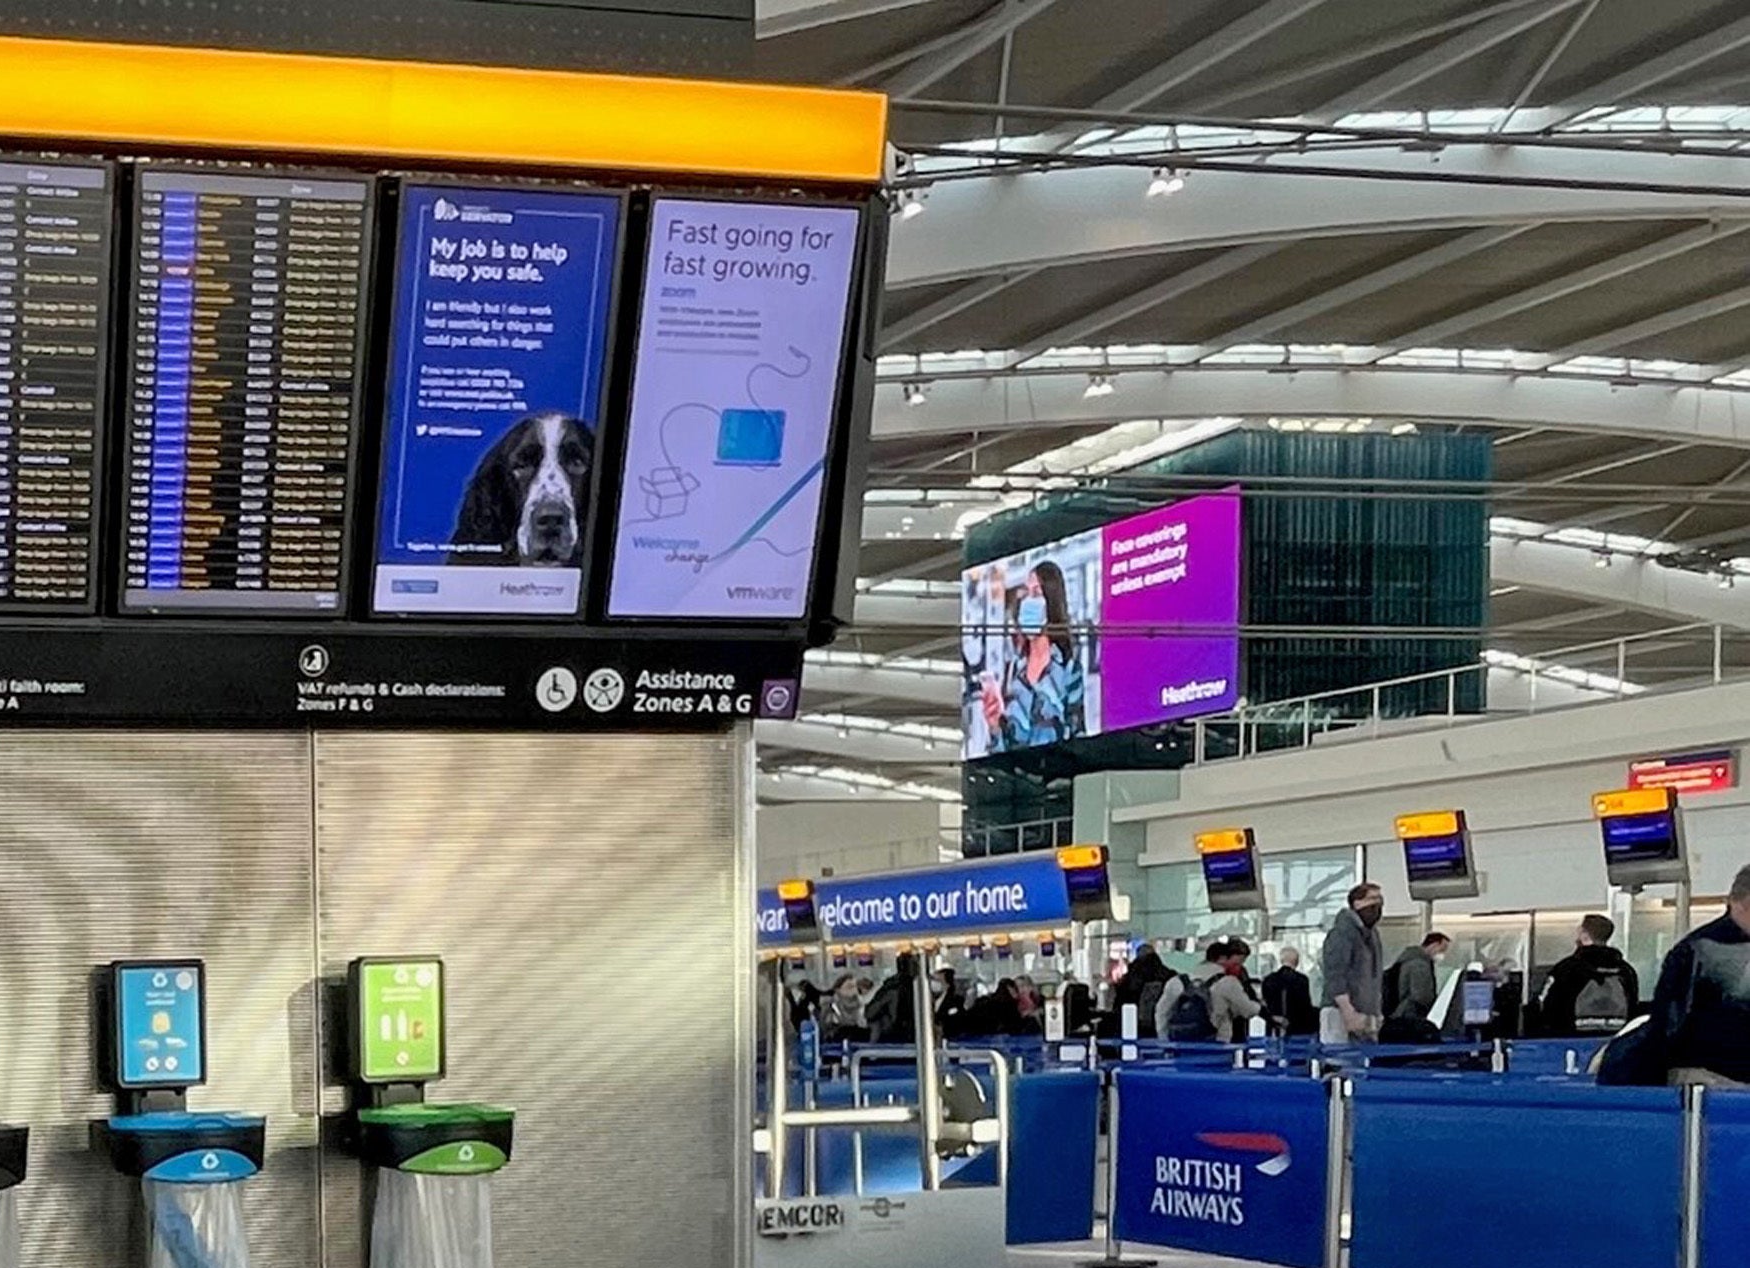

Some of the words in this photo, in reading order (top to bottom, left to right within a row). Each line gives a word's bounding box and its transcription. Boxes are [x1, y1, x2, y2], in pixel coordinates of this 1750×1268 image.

[668, 219, 718, 245] Fast
[725, 224, 793, 252] going
[801, 226, 834, 250] for
[431, 237, 457, 259] My
[460, 238, 487, 261] job
[491, 239, 505, 259] is
[510, 243, 528, 260] to
[532, 242, 568, 266] help
[429, 259, 468, 282] keep
[472, 265, 503, 282] you
[506, 263, 544, 282] safe.
[663, 252, 706, 277] fast
[712, 256, 817, 286] growing.
[499, 582, 564, 597] Heathrow
[10, 679, 42, 693] faith
[297, 682, 325, 695] VAT
[326, 682, 376, 696] refunds
[378, 683, 389, 696] &
[392, 683, 424, 696] Cash
[635, 668, 735, 690] Assistance
[6, 696, 19, 710] A
[633, 692, 694, 713] Zones
[697, 694, 714, 713] A
[716, 694, 732, 713] &
[735, 694, 753, 713] G
[1161, 678, 1227, 706] Heathrow
[297, 698, 336, 711] Zones
[338, 698, 347, 711] F
[362, 698, 374, 711] G
[899, 893, 918, 921] to
[926, 890, 961, 918] our
[965, 880, 1028, 914] home.
[1155, 1155, 1242, 1194] BRITISH
[1150, 1186, 1244, 1226] AIRWAYS
